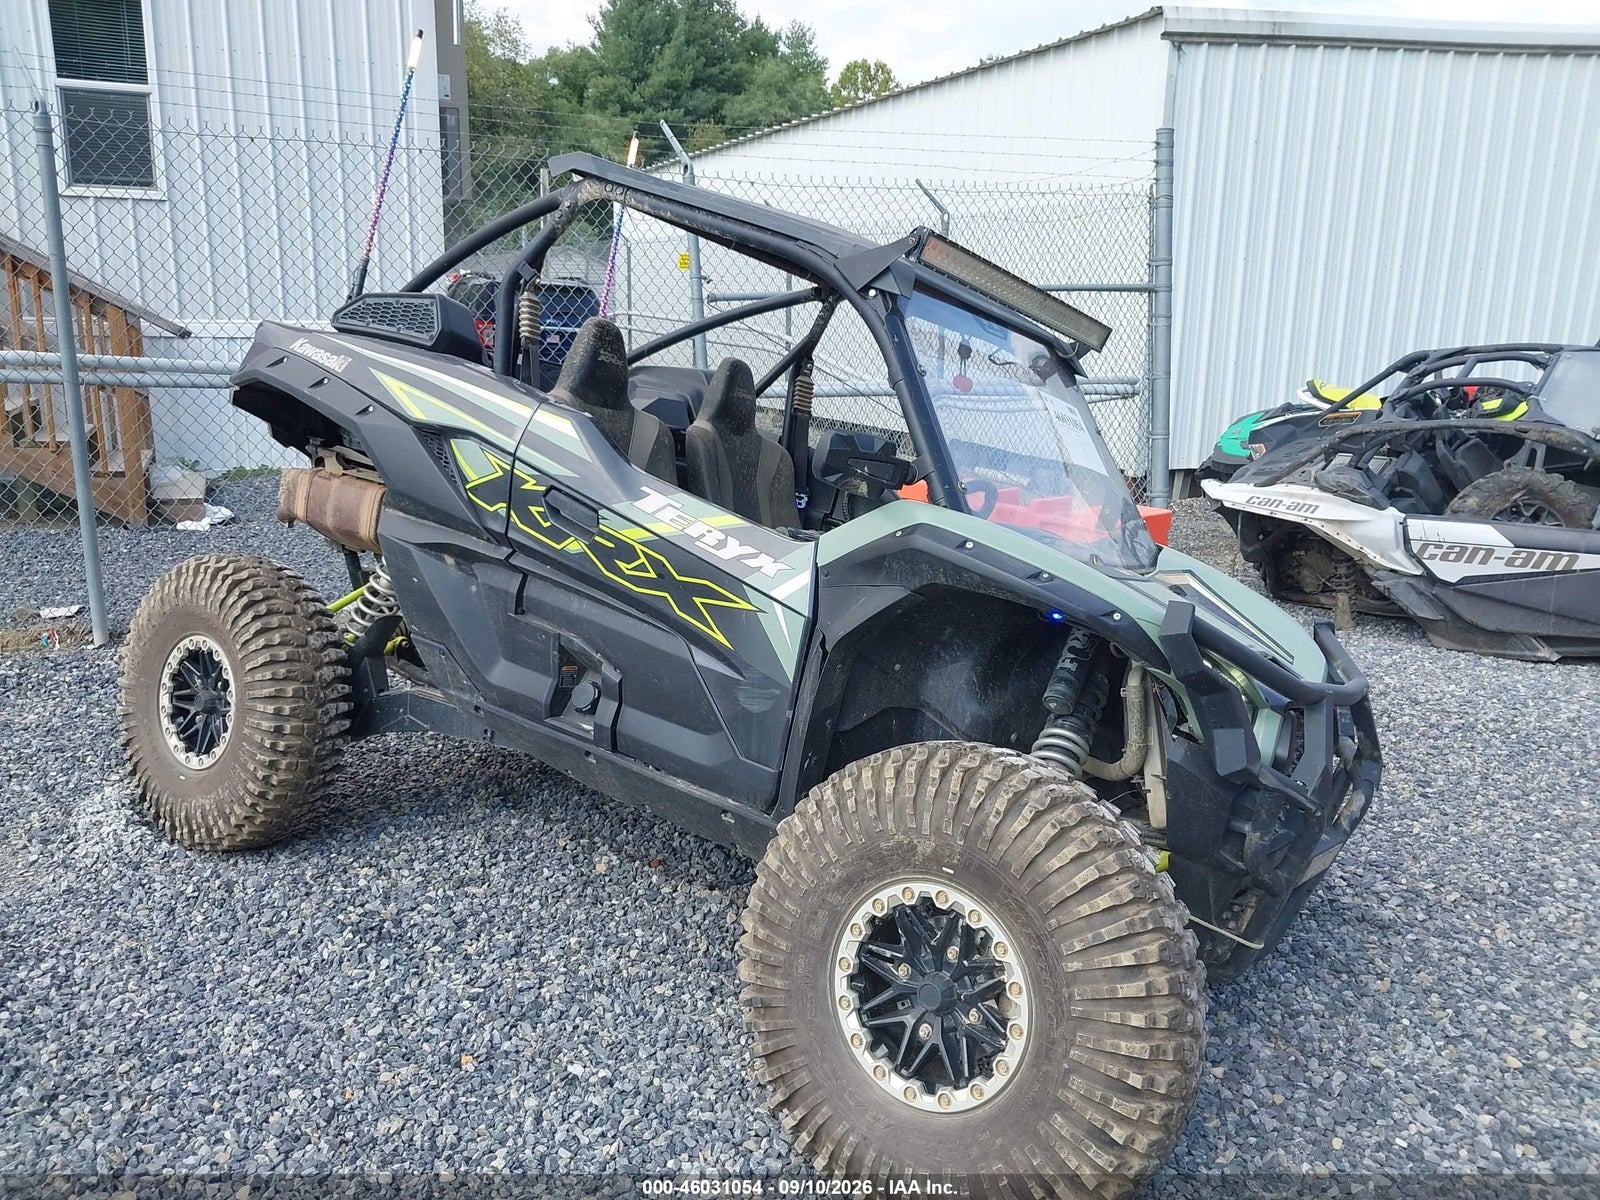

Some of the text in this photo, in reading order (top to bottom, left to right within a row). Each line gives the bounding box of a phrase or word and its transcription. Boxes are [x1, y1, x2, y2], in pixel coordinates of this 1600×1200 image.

[289, 337, 353, 373] Kawasaki
[1245, 495, 1320, 514] can-am
[1416, 542, 1580, 571] can-am
[1056, 627, 1096, 672] FOX
